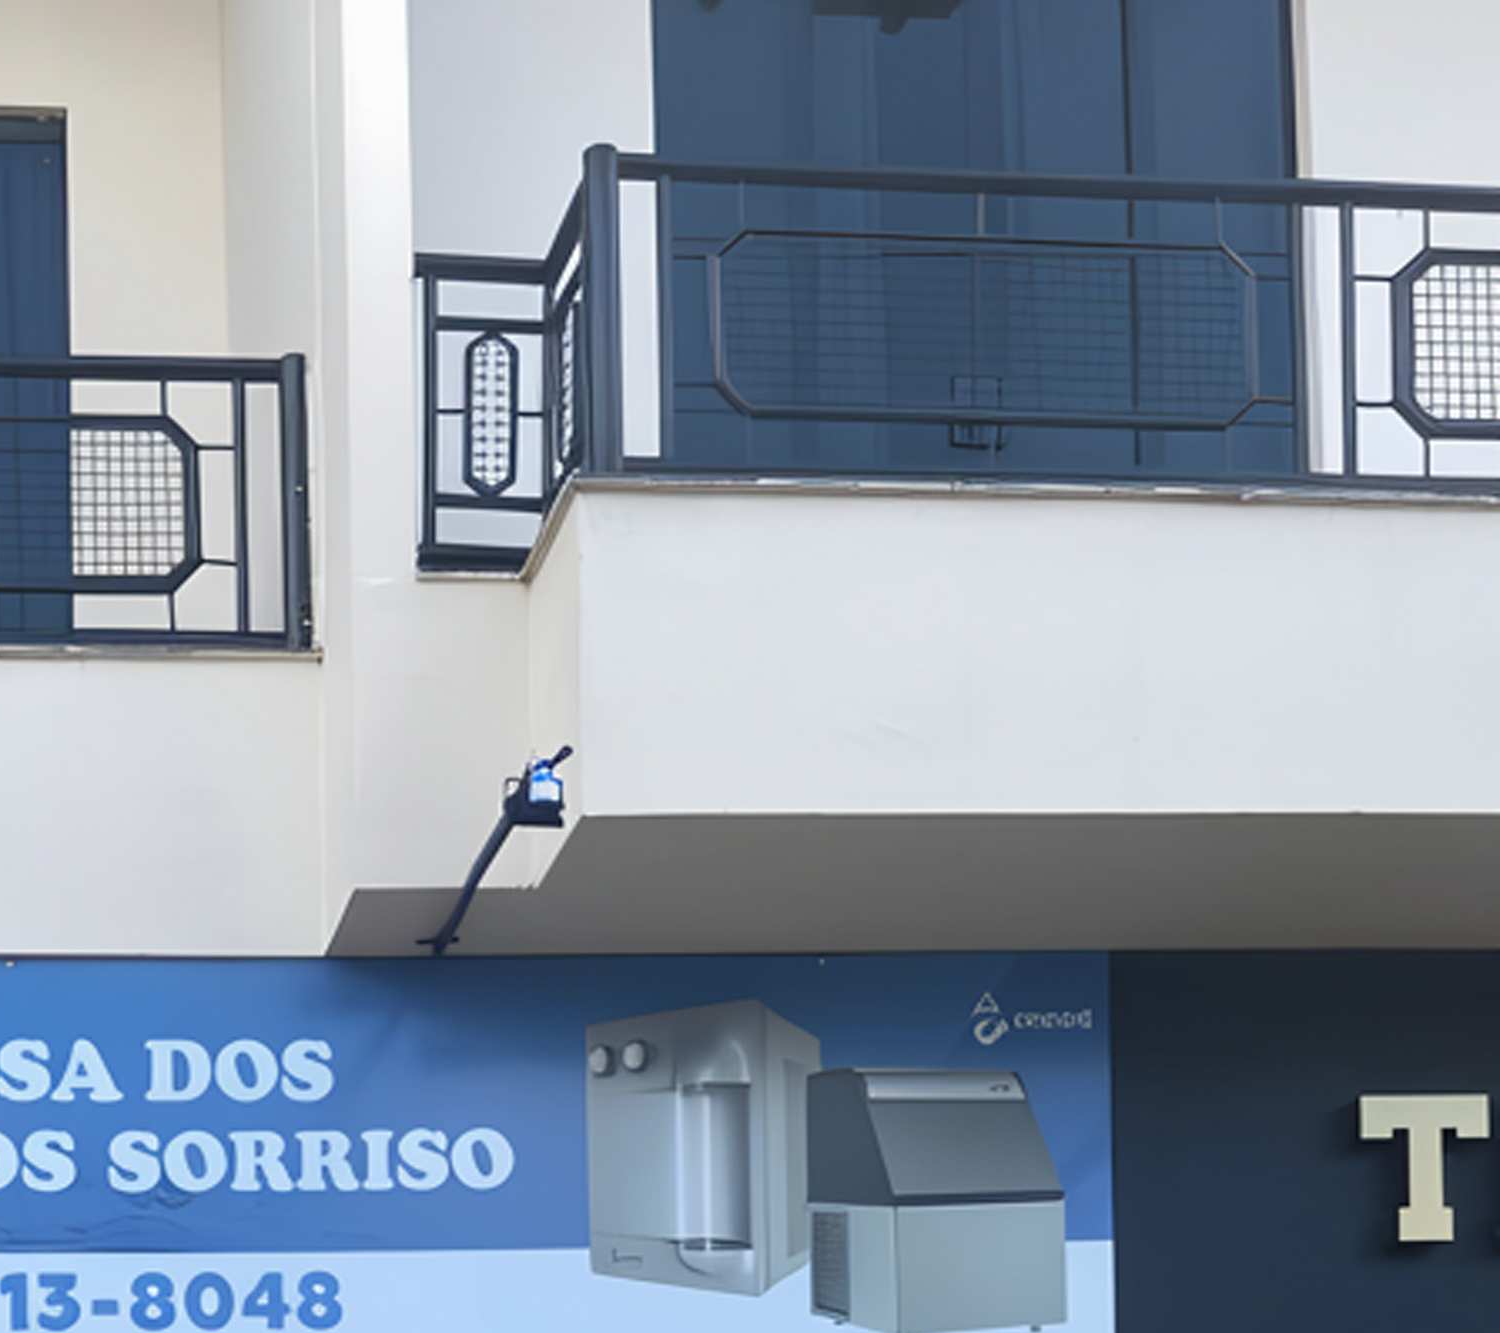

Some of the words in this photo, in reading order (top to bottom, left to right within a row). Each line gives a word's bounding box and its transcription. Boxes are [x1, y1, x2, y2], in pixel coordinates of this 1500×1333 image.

[144, 1038, 335, 1102] DOS
[108, 1126, 515, 1193] SORRISO
[1359, 1094, 1490, 1242] T
